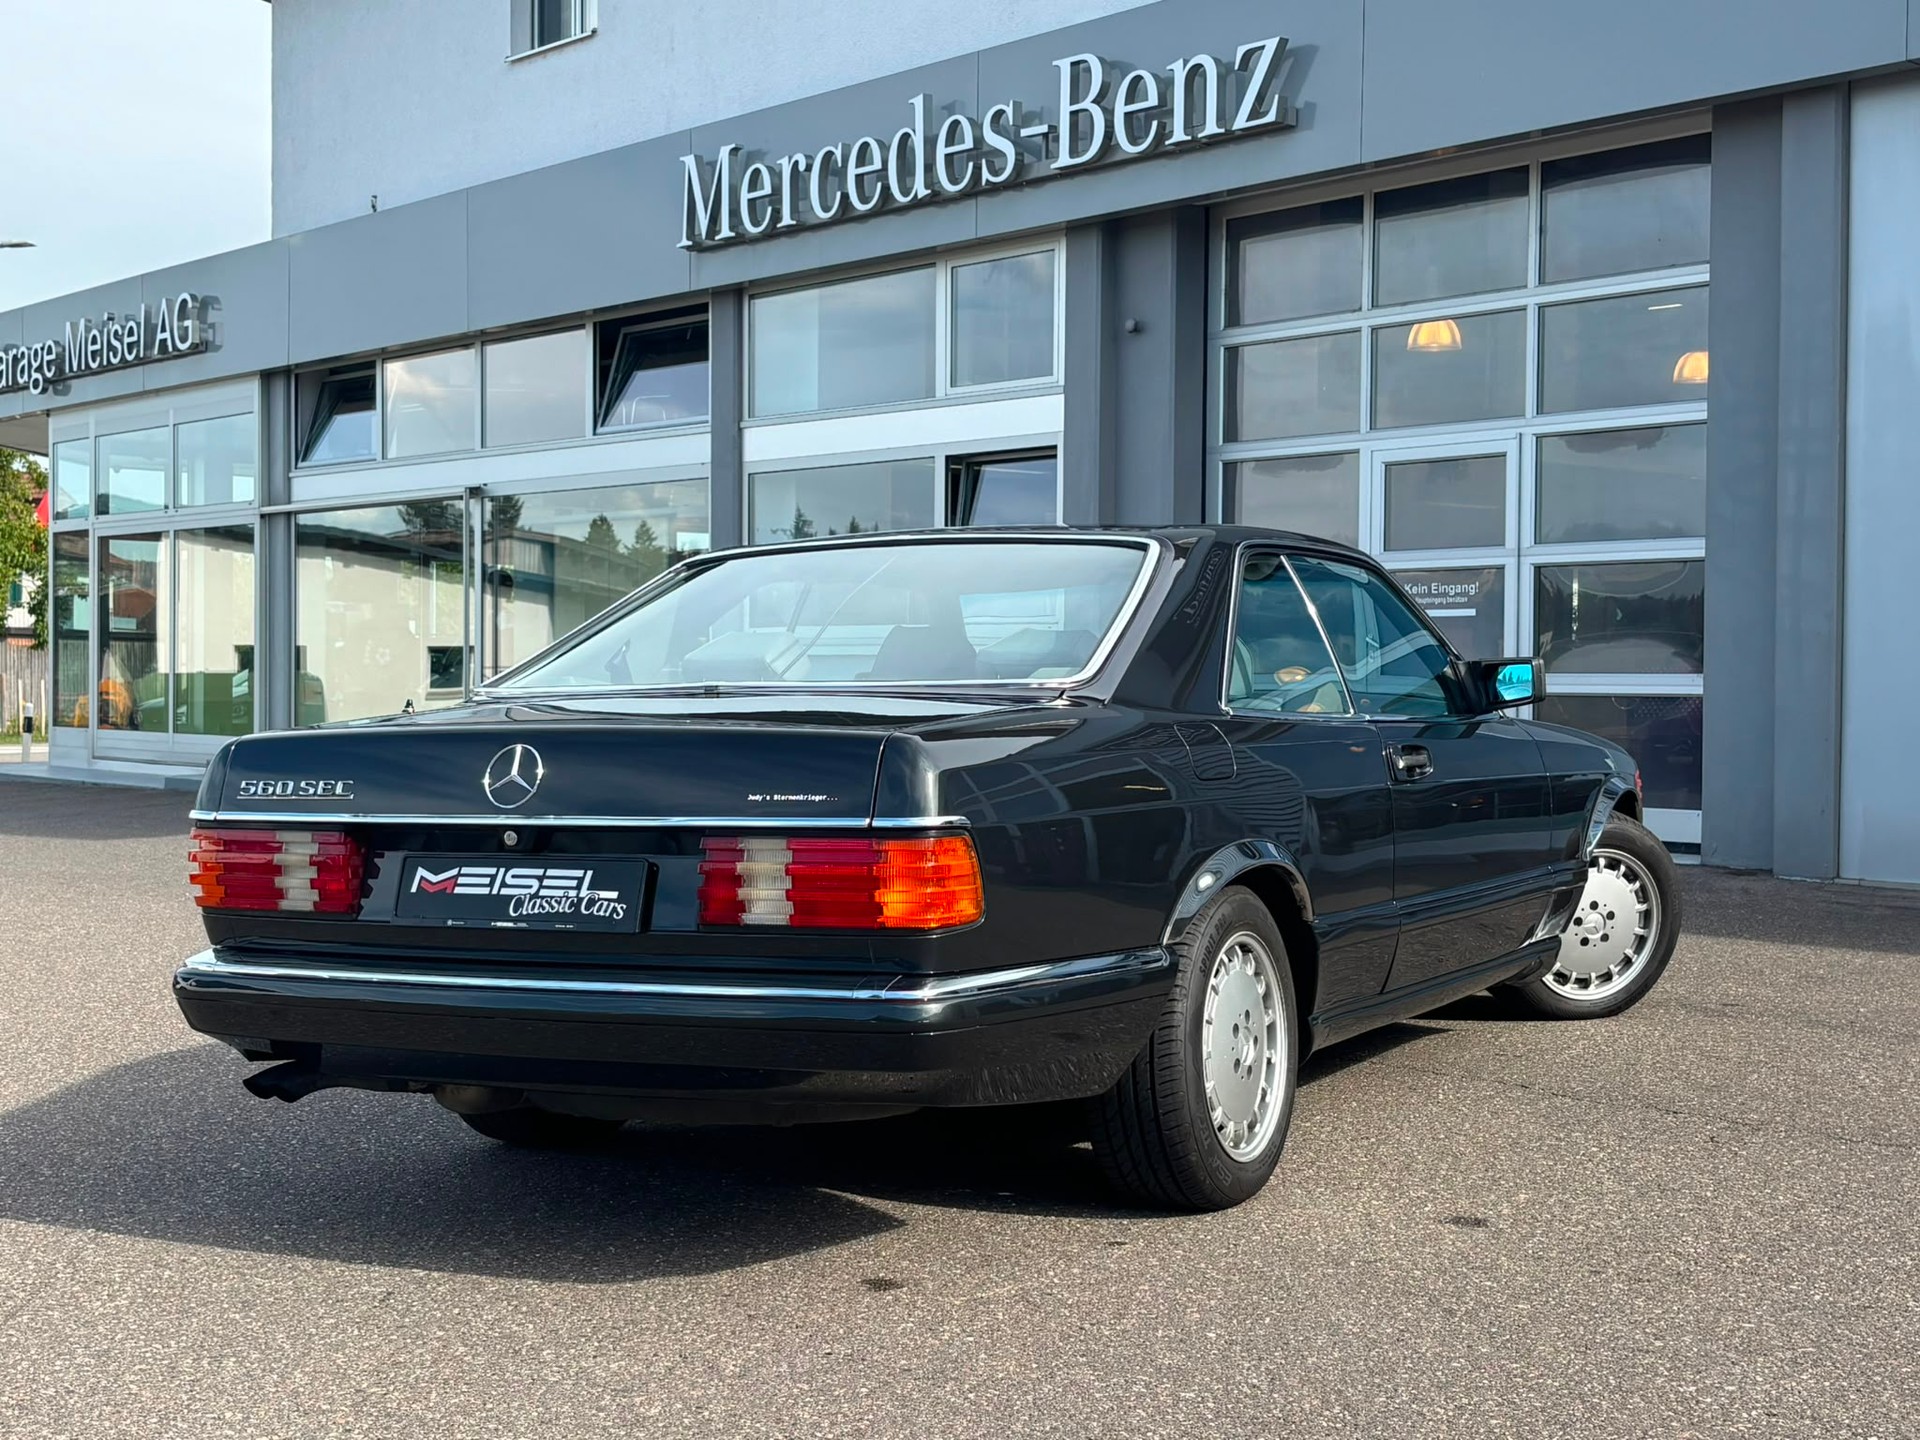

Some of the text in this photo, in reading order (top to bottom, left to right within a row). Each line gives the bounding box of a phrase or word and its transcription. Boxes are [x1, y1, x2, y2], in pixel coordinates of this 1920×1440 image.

[677, 36, 1290, 249] Mercedes-Benz
[65, 303, 145, 373] Meisel
[154, 292, 194, 355] AG
[1404, 581, 1479, 596] Kein Eingang!
[240, 780, 354, 796] 560 SEC
[410, 866, 619, 899] MEISEL
[509, 891, 627, 920] Classic Cars
